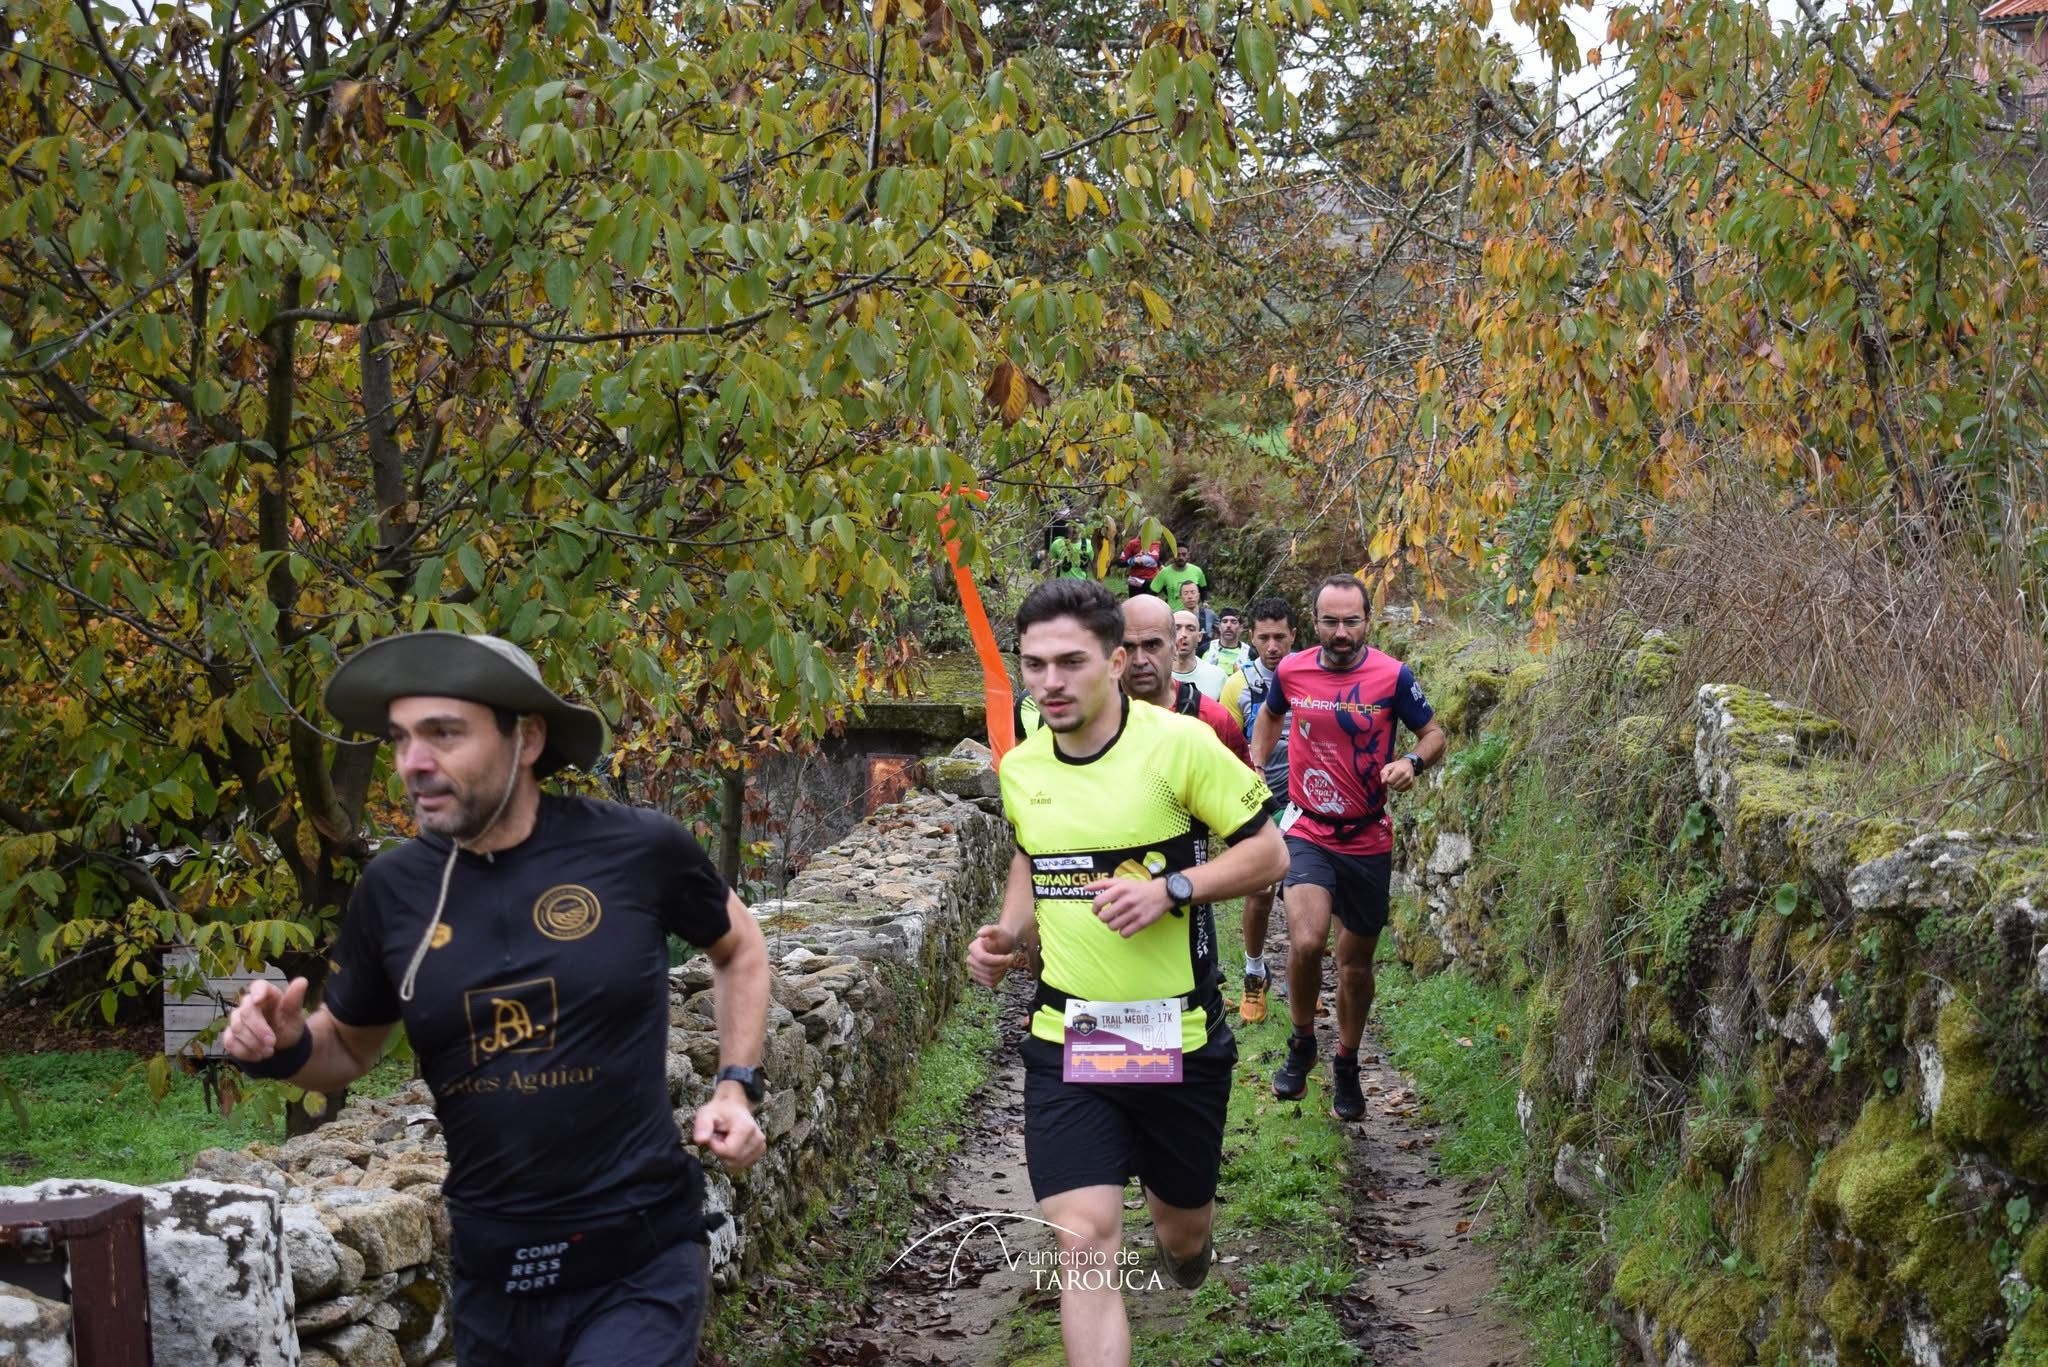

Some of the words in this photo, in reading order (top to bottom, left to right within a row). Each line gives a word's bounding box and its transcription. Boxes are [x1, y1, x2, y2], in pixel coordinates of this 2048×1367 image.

[1102, 1015, 1122, 1025] TRAIL
[1158, 1012, 1173, 1023] 17K
[515, 1241, 569, 1260] COMP
[511, 1258, 561, 1277] RESS
[505, 1273, 560, 1293] PORT
